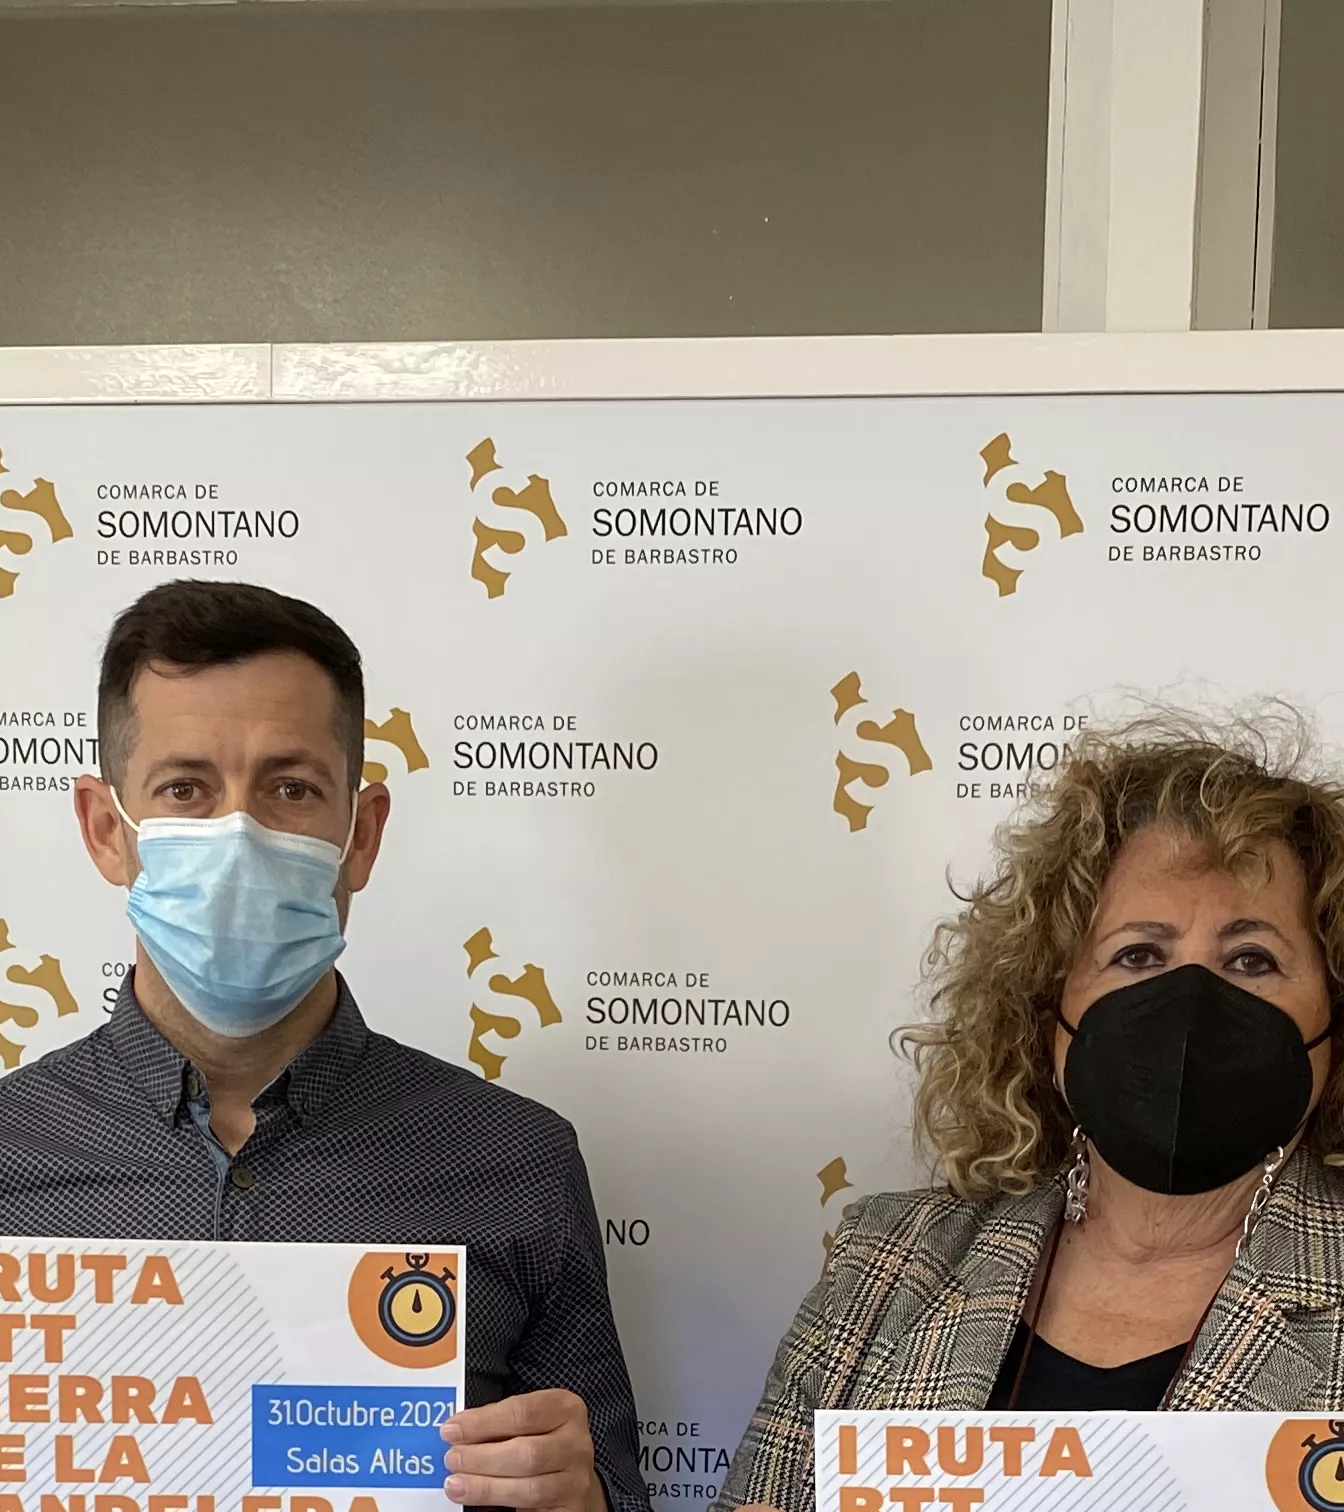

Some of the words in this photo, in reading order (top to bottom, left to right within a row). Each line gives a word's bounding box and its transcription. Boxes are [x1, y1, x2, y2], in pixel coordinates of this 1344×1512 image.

[97, 484, 187, 499] COMARCA
[196, 485, 218, 499] DE
[1112, 477, 1208, 493] COMARCA
[1219, 477, 1243, 492] DE
[97, 510, 299, 538] SOMONTANO
[1110, 504, 1329, 533] SOMONTANO
[98, 550, 120, 565] DE
[129, 550, 237, 565] BARBASTRO
[1109, 546, 1133, 561] DE
[1143, 545, 1261, 561] BARBASTRO
[454, 715, 544, 730] COMARCA
[554, 716, 576, 731] DE
[454, 741, 658, 770] SOMONTANO
[454, 781, 476, 796] DE
[486, 782, 595, 797] BARBASTRO
[587, 972, 677, 987] COMARCA
[686, 973, 709, 987] DE
[586, 997, 789, 1027] SOMONTANO
[586, 1036, 609, 1050] DE
[618, 1037, 726, 1052] BARBASTRO
[839, 1426, 856, 1474] I
[886, 1427, 1091, 1476] RUTA
[56, 1436, 148, 1483] LA
[287, 1448, 359, 1473] Salas
[370, 1449, 434, 1474] Altas
